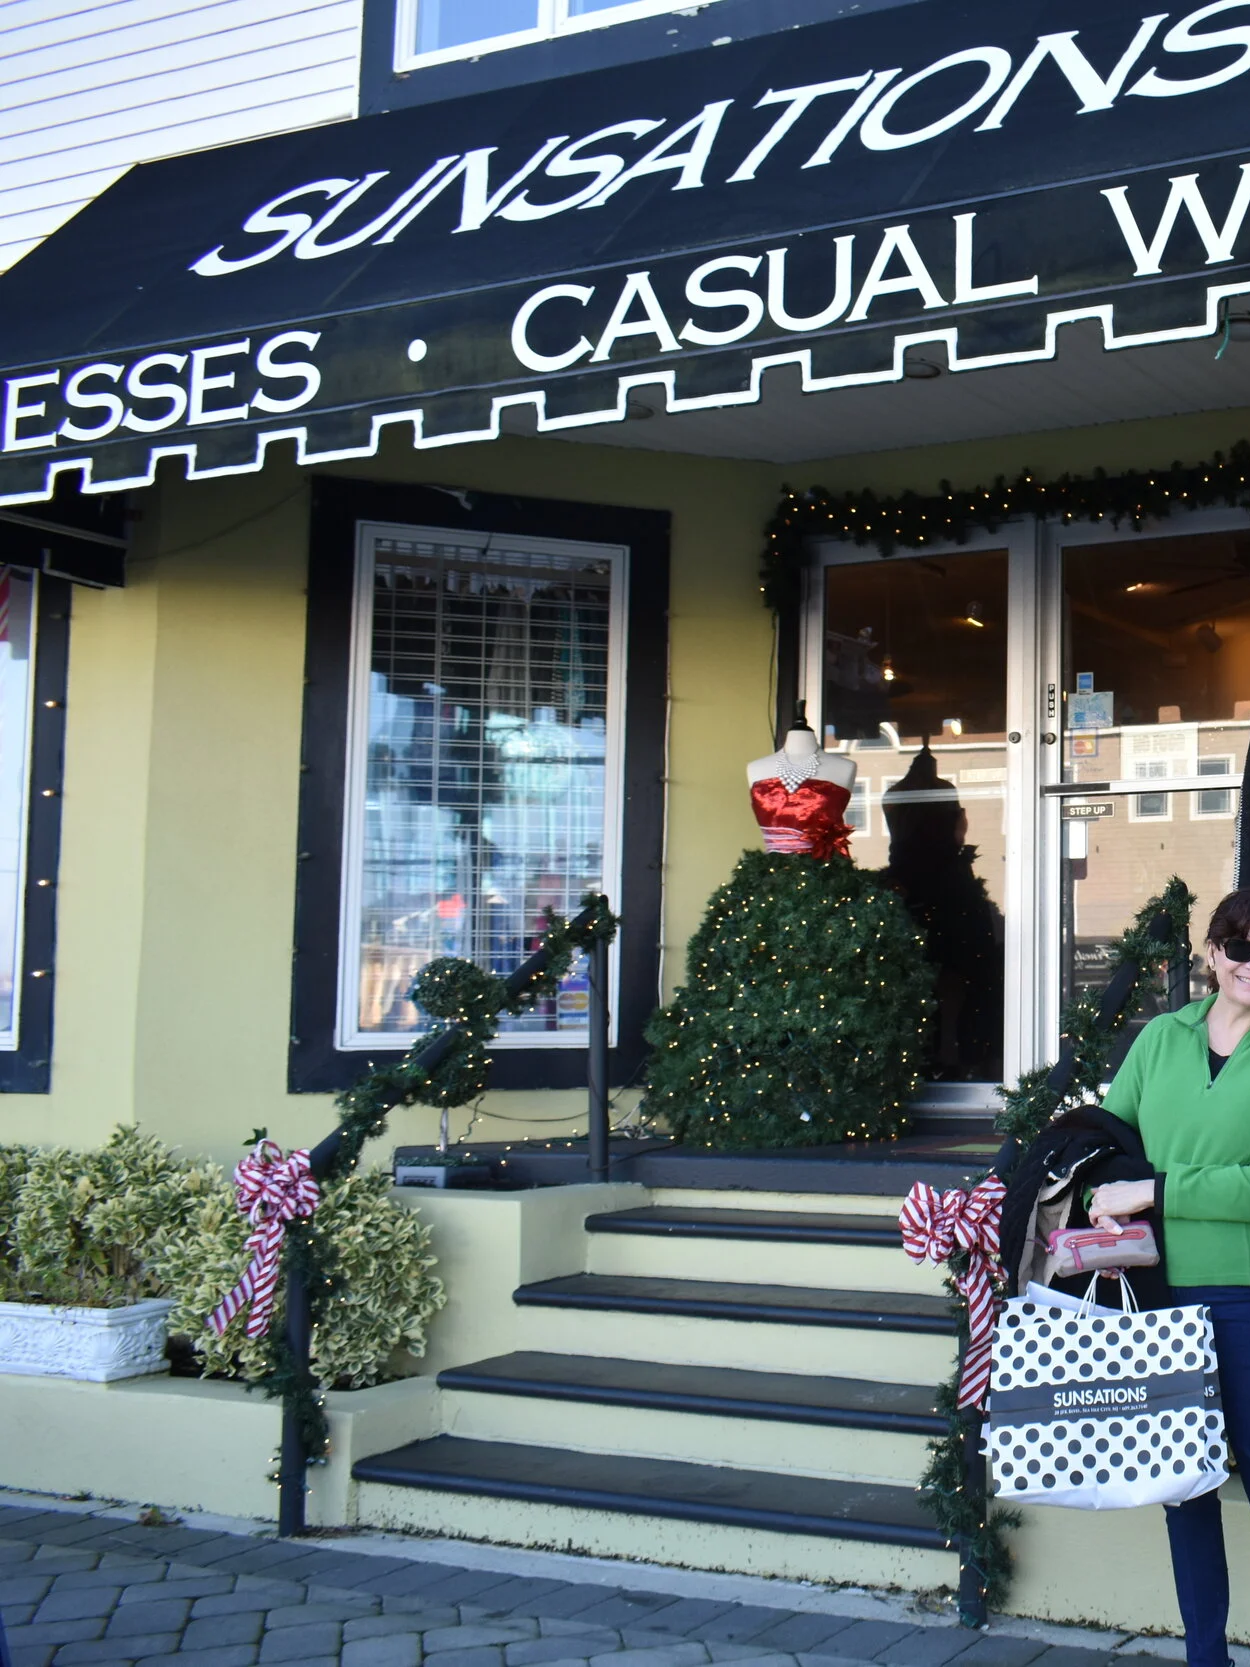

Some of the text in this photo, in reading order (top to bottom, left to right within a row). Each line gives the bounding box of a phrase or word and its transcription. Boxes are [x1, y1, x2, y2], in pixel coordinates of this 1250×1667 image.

[2, 331, 322, 453] ESSES
[511, 212, 1039, 372] CASUAL
[1069, 805, 1106, 816] STEP UP
[1053, 1386, 1147, 1407] SUNSATIONS
